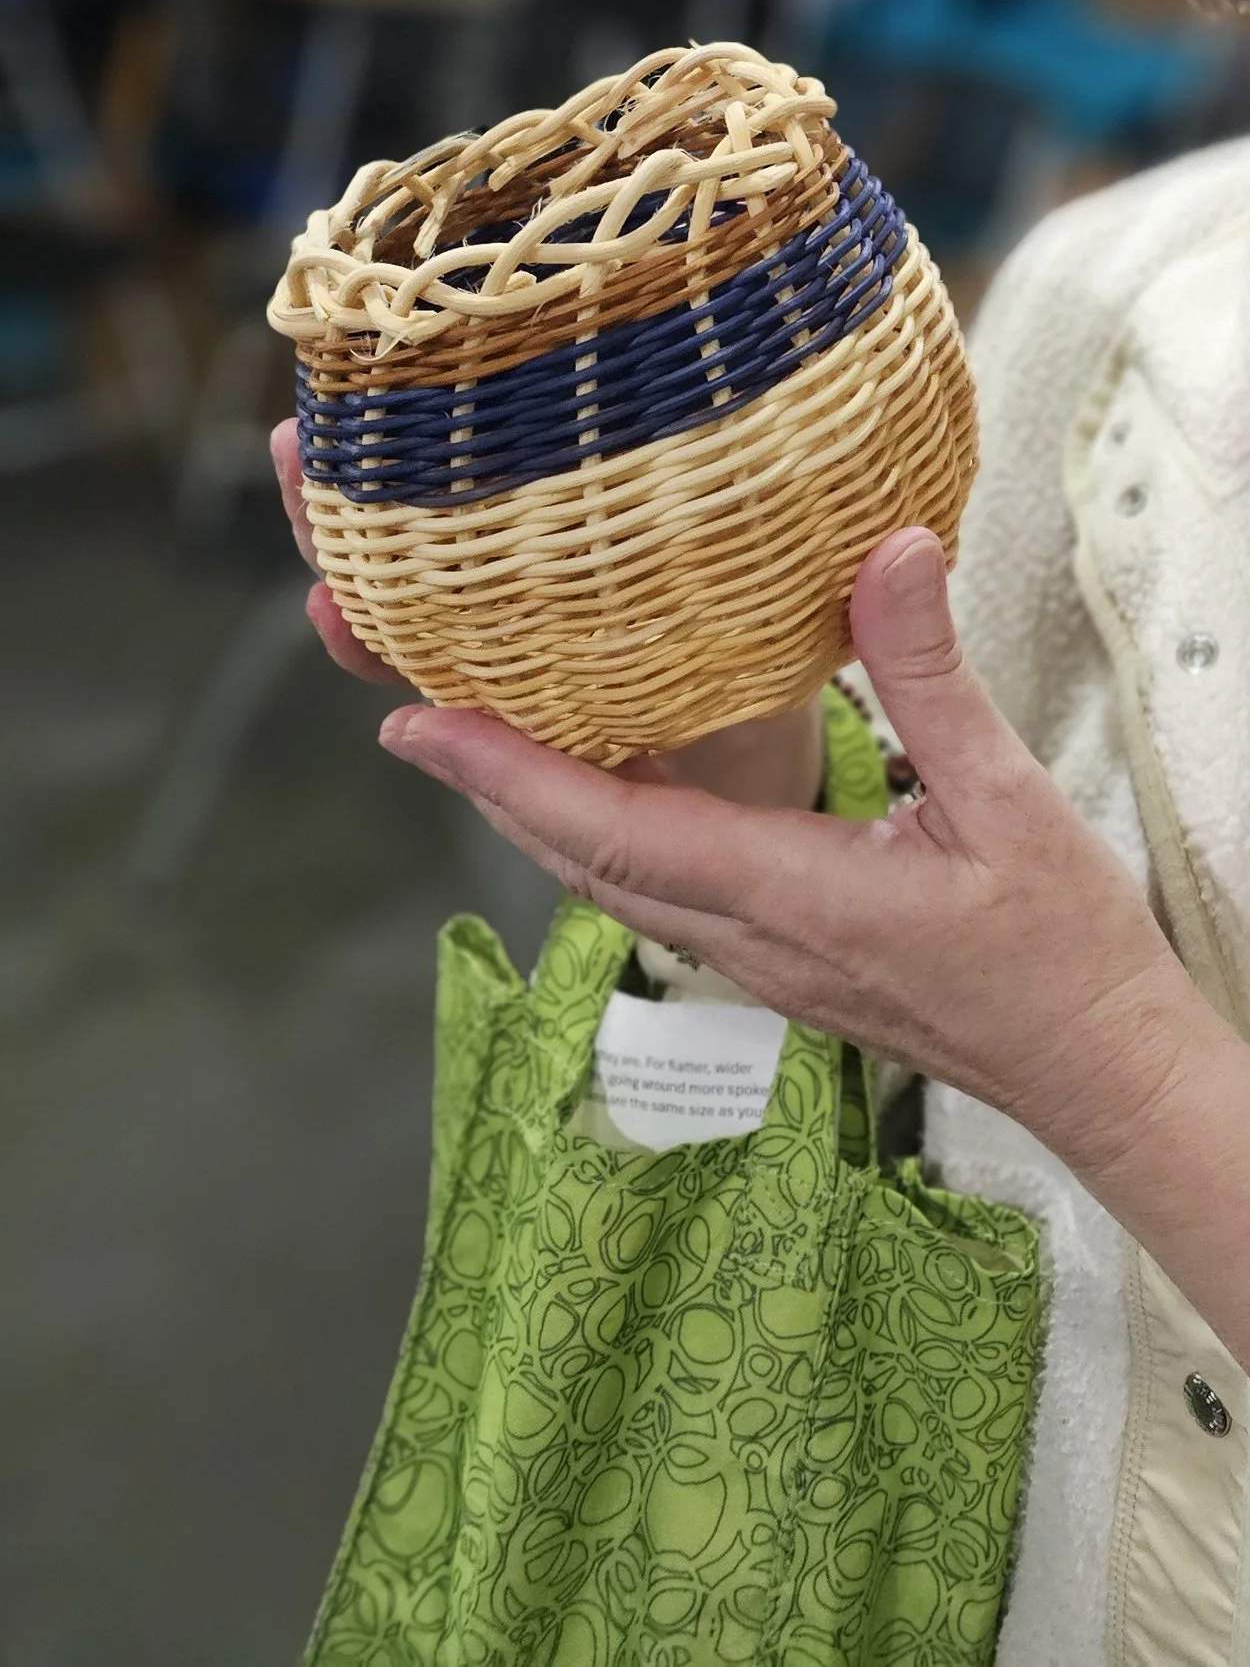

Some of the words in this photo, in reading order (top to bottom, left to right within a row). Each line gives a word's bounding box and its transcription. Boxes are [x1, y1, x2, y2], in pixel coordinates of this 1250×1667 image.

[646, 1055, 665, 1070] For
[715, 1061, 753, 1075] wider
[607, 1074, 640, 1091] going
[641, 1079, 686, 1095] around
[689, 1084, 725, 1096] more
[630, 1096, 649, 1111] the
[651, 1102, 685, 1115] same
[689, 1103, 714, 1117] size
[718, 1105, 735, 1118] as
